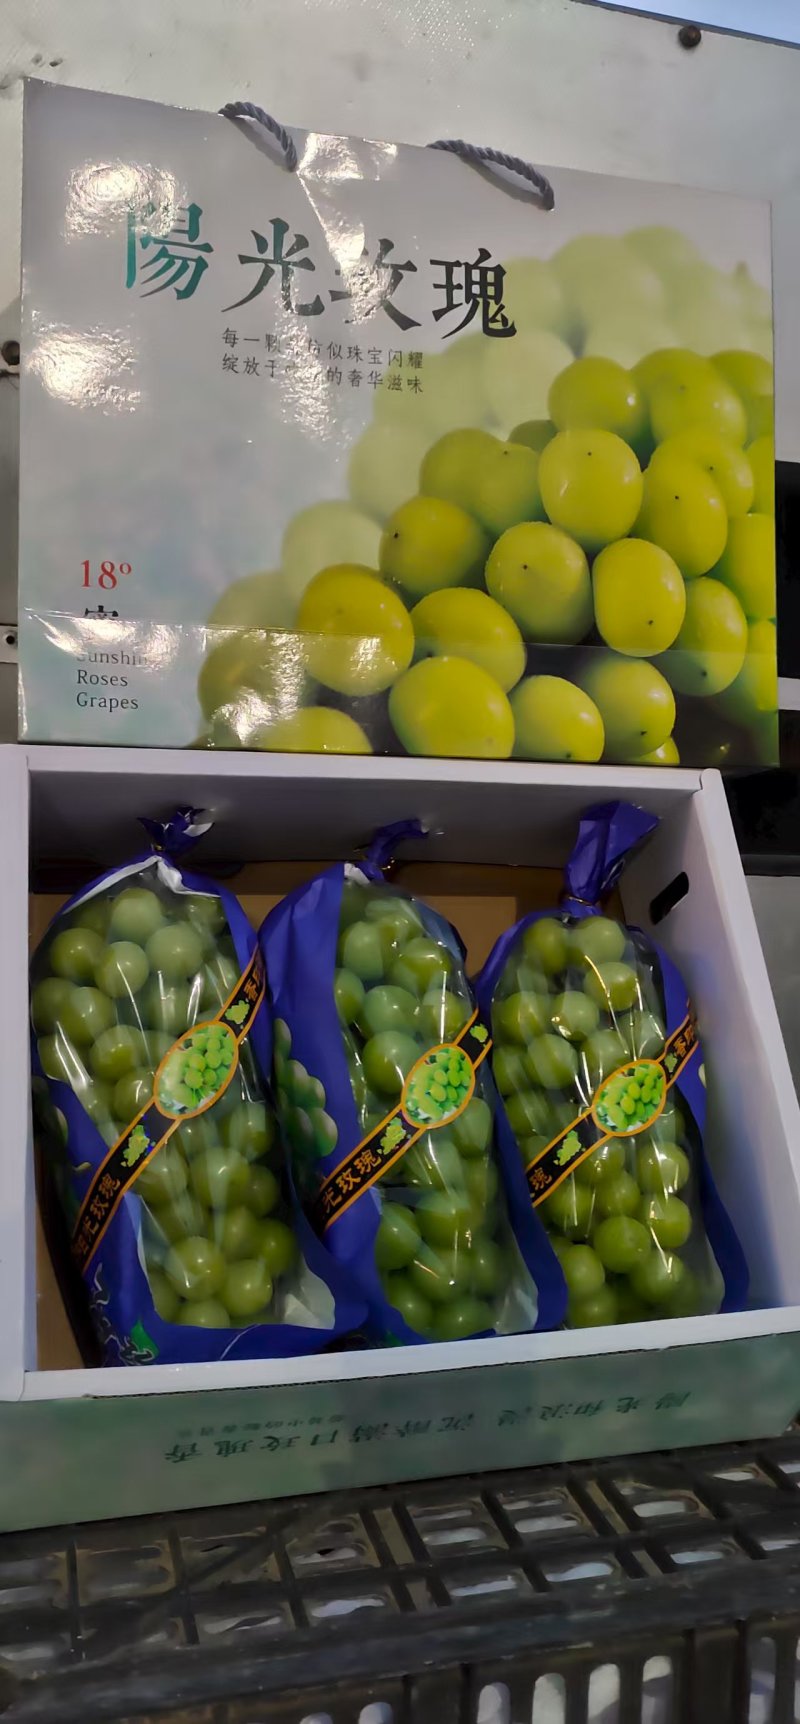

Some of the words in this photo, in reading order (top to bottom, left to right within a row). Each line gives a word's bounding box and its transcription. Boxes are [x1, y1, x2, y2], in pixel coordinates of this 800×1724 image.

[222, 327, 423, 369] 每一颗仿似珠宝闪耀
[222, 353, 424, 394] 绽放于的奢华滋味
[77, 669, 128, 686] Roses
[77, 692, 139, 712] Grapes
[530, 1167, 552, 1197] 瑰
